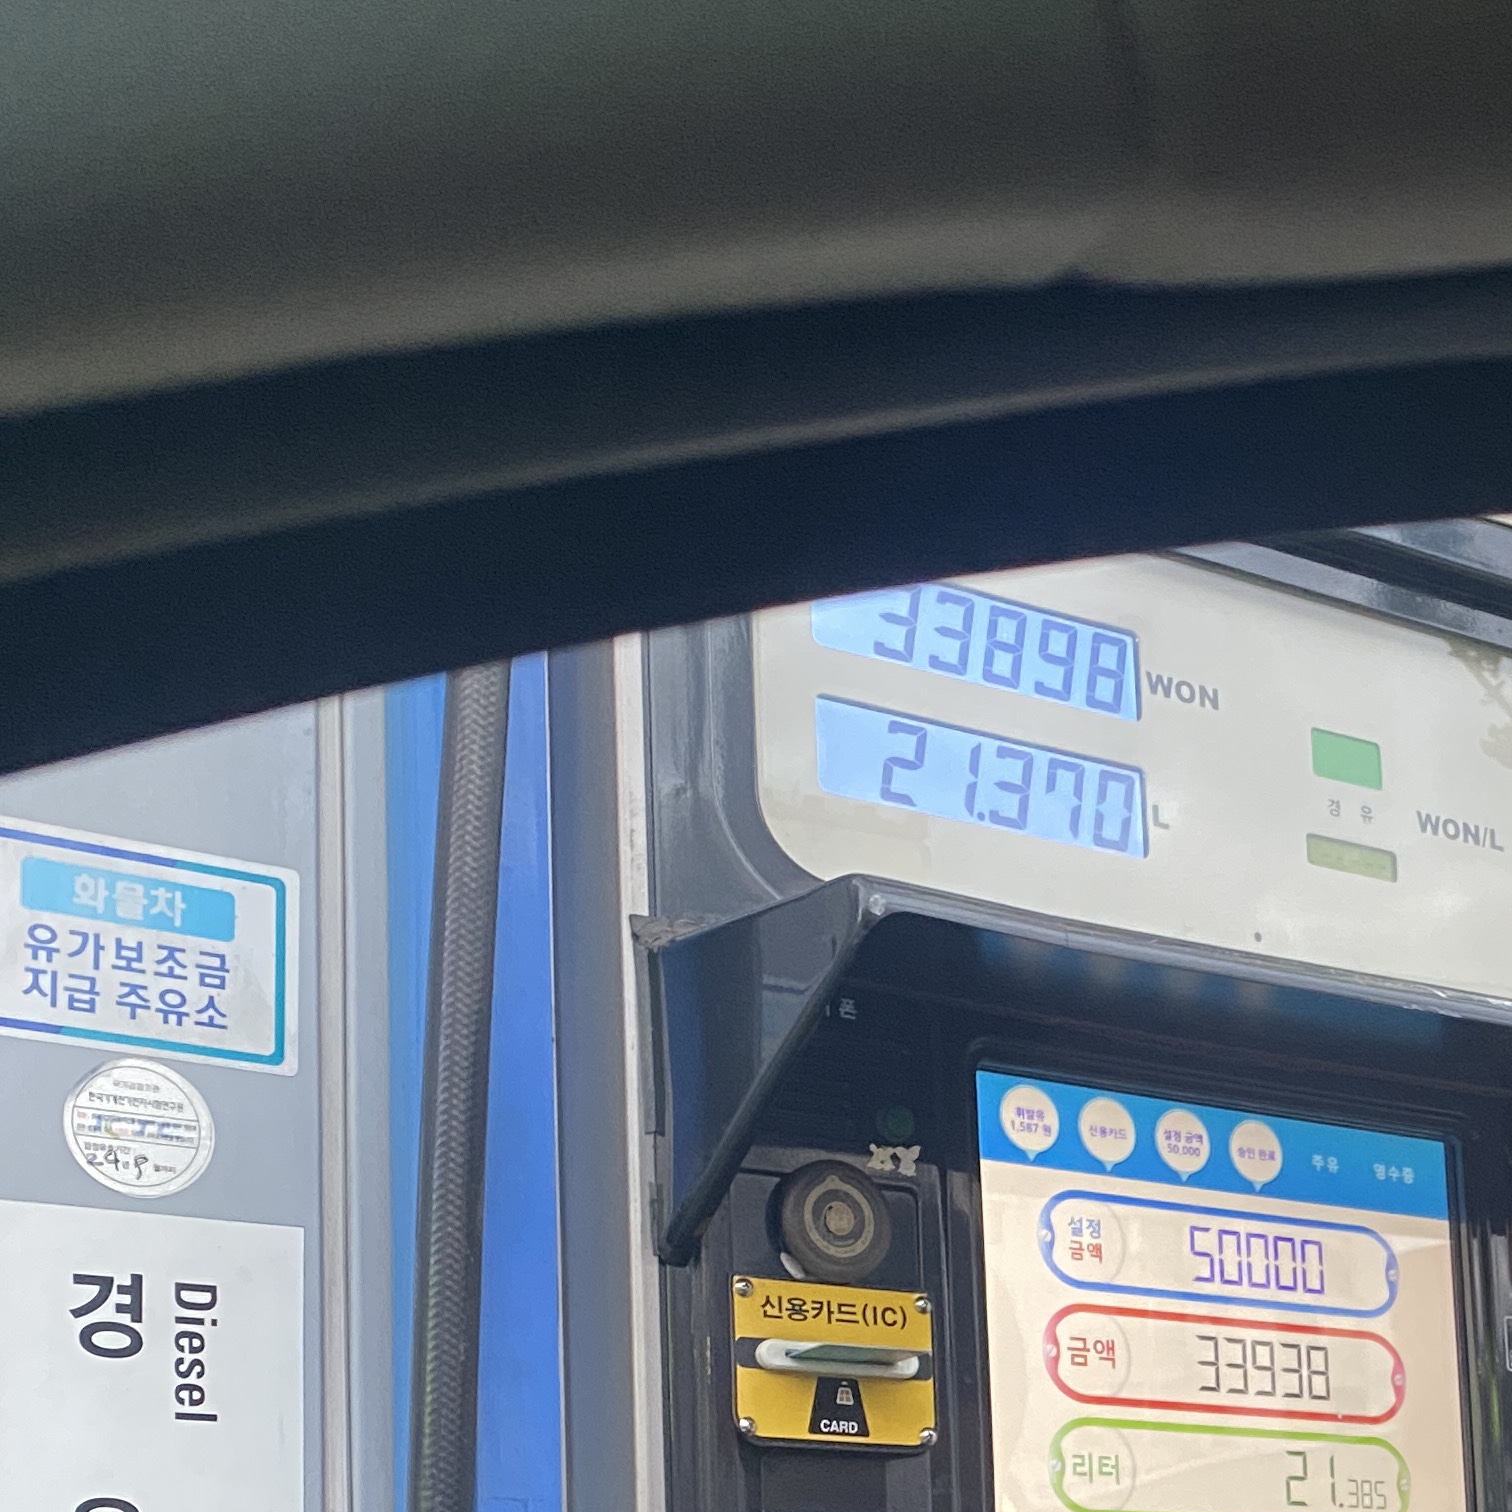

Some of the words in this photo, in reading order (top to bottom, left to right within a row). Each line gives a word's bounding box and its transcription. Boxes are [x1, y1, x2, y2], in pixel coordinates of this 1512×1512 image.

[872, 585, 1127, 714] 33898
[1146, 671, 1219, 710] WON
[879, 719, 1135, 853] 21.370
[1152, 804, 1169, 830] L
[1416, 810, 1505, 852] WON/L
[73, 873, 186, 927] 화물차
[23, 923, 230, 990] 유가보조금
[22, 967, 101, 1014] 지급
[115, 981, 229, 1030] 주유소
[1088, 1124, 1128, 1140] 신용카드
[1163, 1128, 1182, 1143] 설정
[1185, 1132, 1204, 1146] 금액
[1311, 1154, 1340, 1173] 주유
[1067, 1216, 1102, 1240] 설정
[1068, 1241, 1103, 1265] 금액
[1188, 1225, 1326, 1295] 50000
[760, 1294, 908, 1331] 신용카드(IC)
[174, 1281, 218, 1422] Diesel
[1066, 1337, 1117, 1369] 금액
[1197, 1335, 1331, 1401] 33938
[820, 1419, 859, 1435] CARD
[1071, 1453, 1121, 1486] 리터
